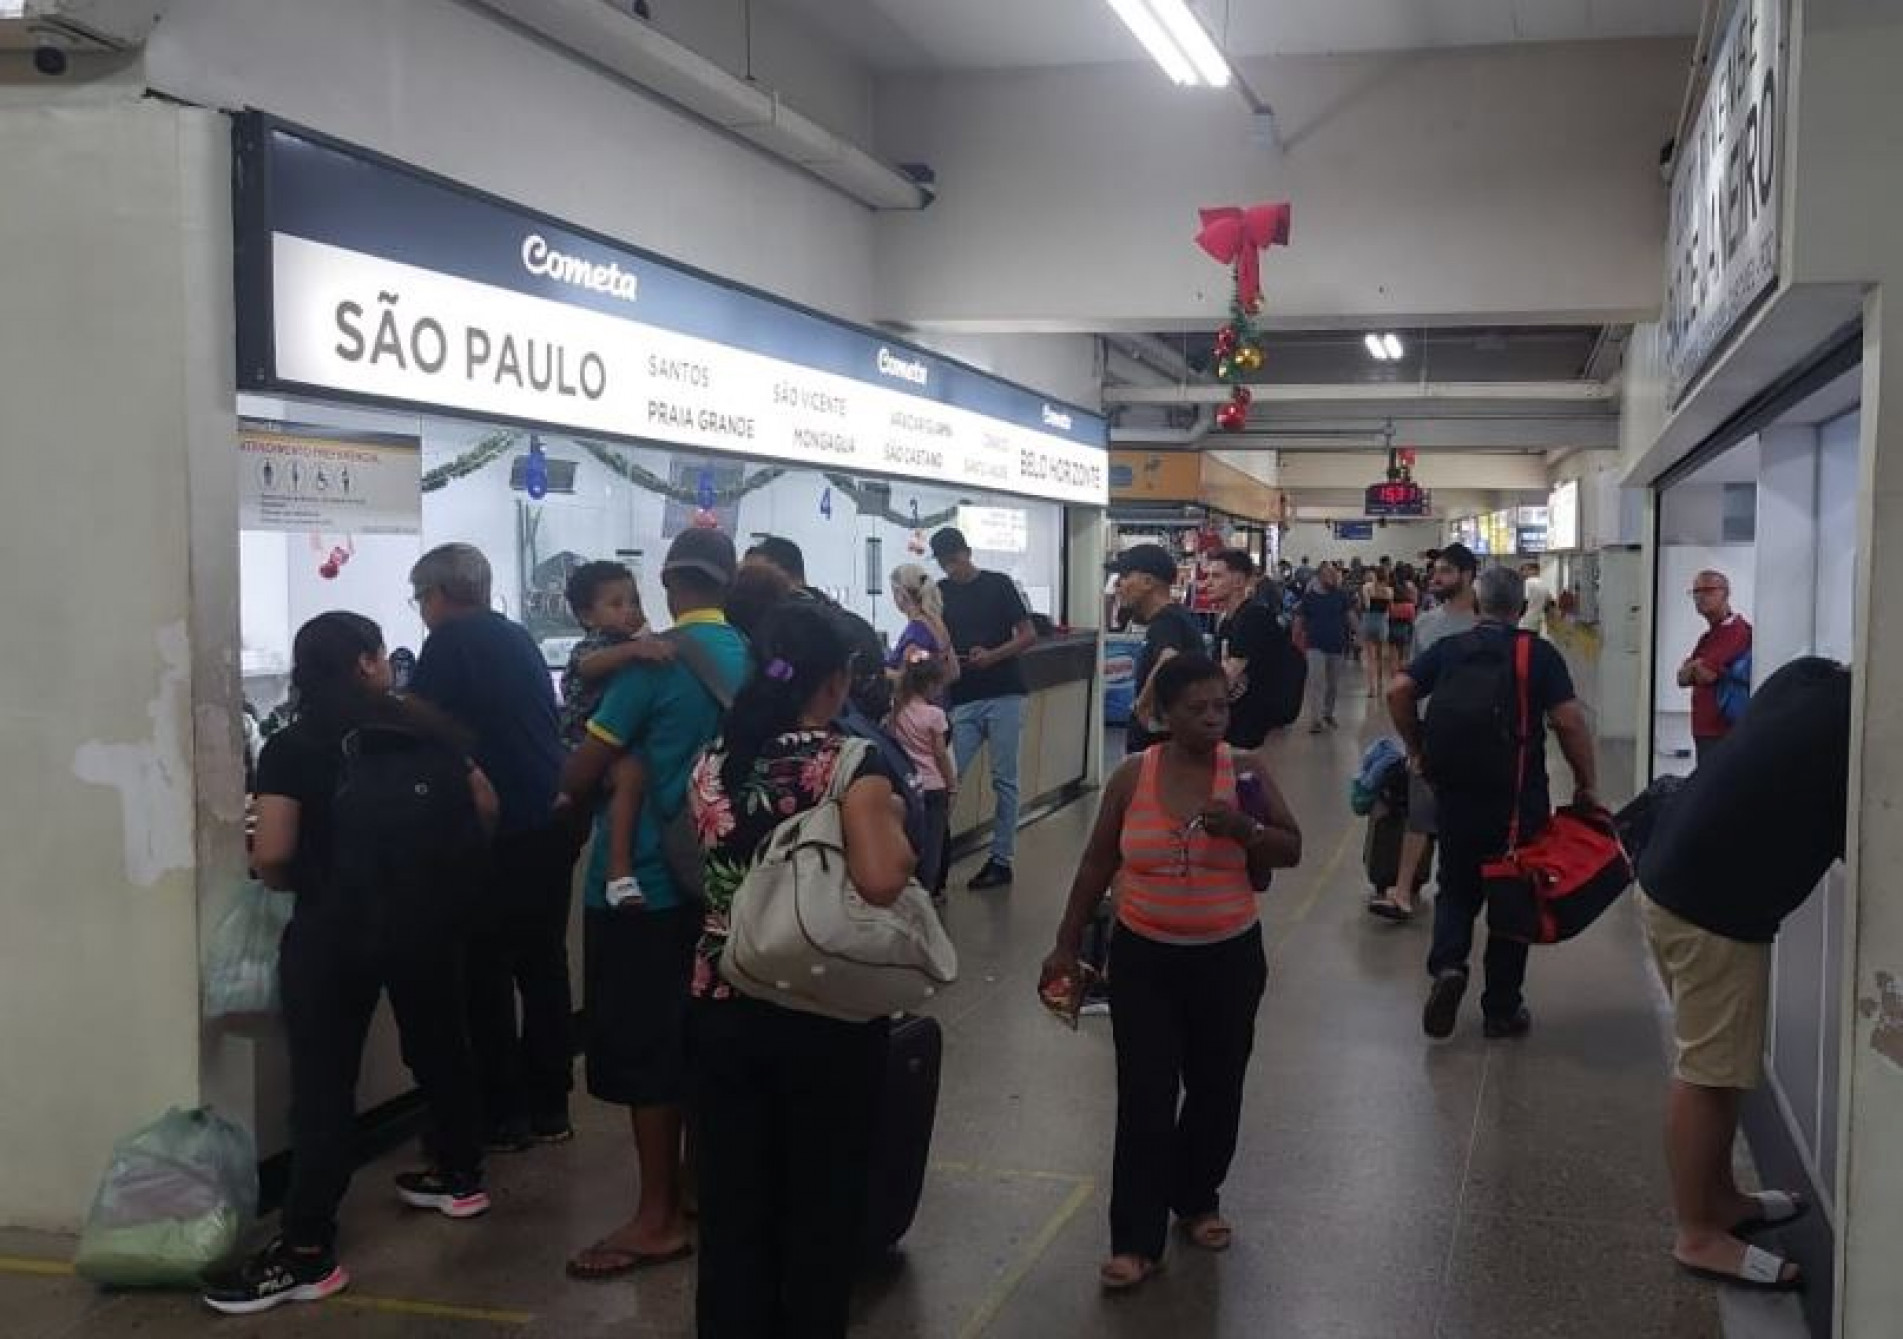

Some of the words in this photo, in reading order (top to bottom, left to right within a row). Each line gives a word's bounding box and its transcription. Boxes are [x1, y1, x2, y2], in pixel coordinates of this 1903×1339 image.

[521, 235, 637, 301] Cometa
[335, 291, 447, 373] SÃO
[466, 326, 606, 400] PAULO
[648, 354, 709, 388] SANTOS
[648, 400, 693, 429] PRAIA
[698, 410, 756, 439] GRANDE
[820, 487, 831, 521] 4
